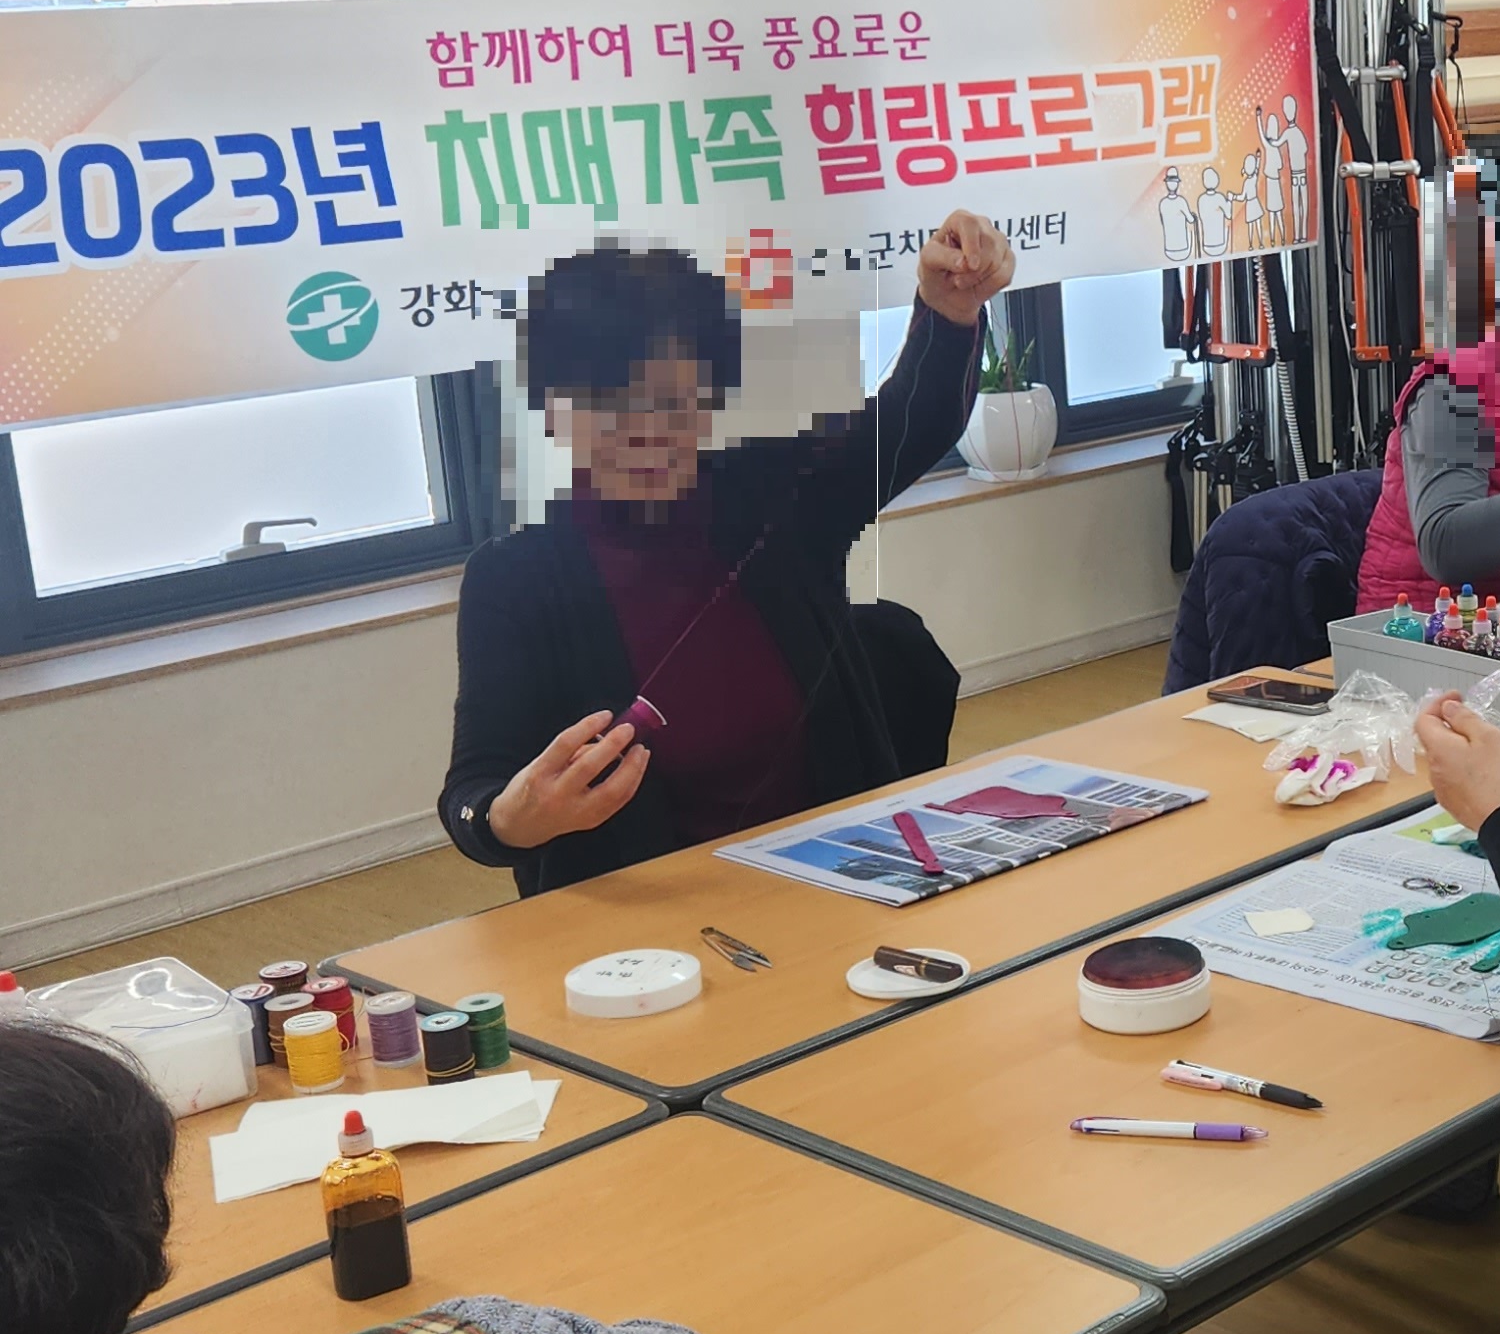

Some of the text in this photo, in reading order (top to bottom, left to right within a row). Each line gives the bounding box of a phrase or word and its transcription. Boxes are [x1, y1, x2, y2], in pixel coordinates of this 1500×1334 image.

[425, 9, 932, 89] 함께하여 더욱 풍요로운
[0, 60, 1219, 269] 2023년 치매가족 힐링프로그램
